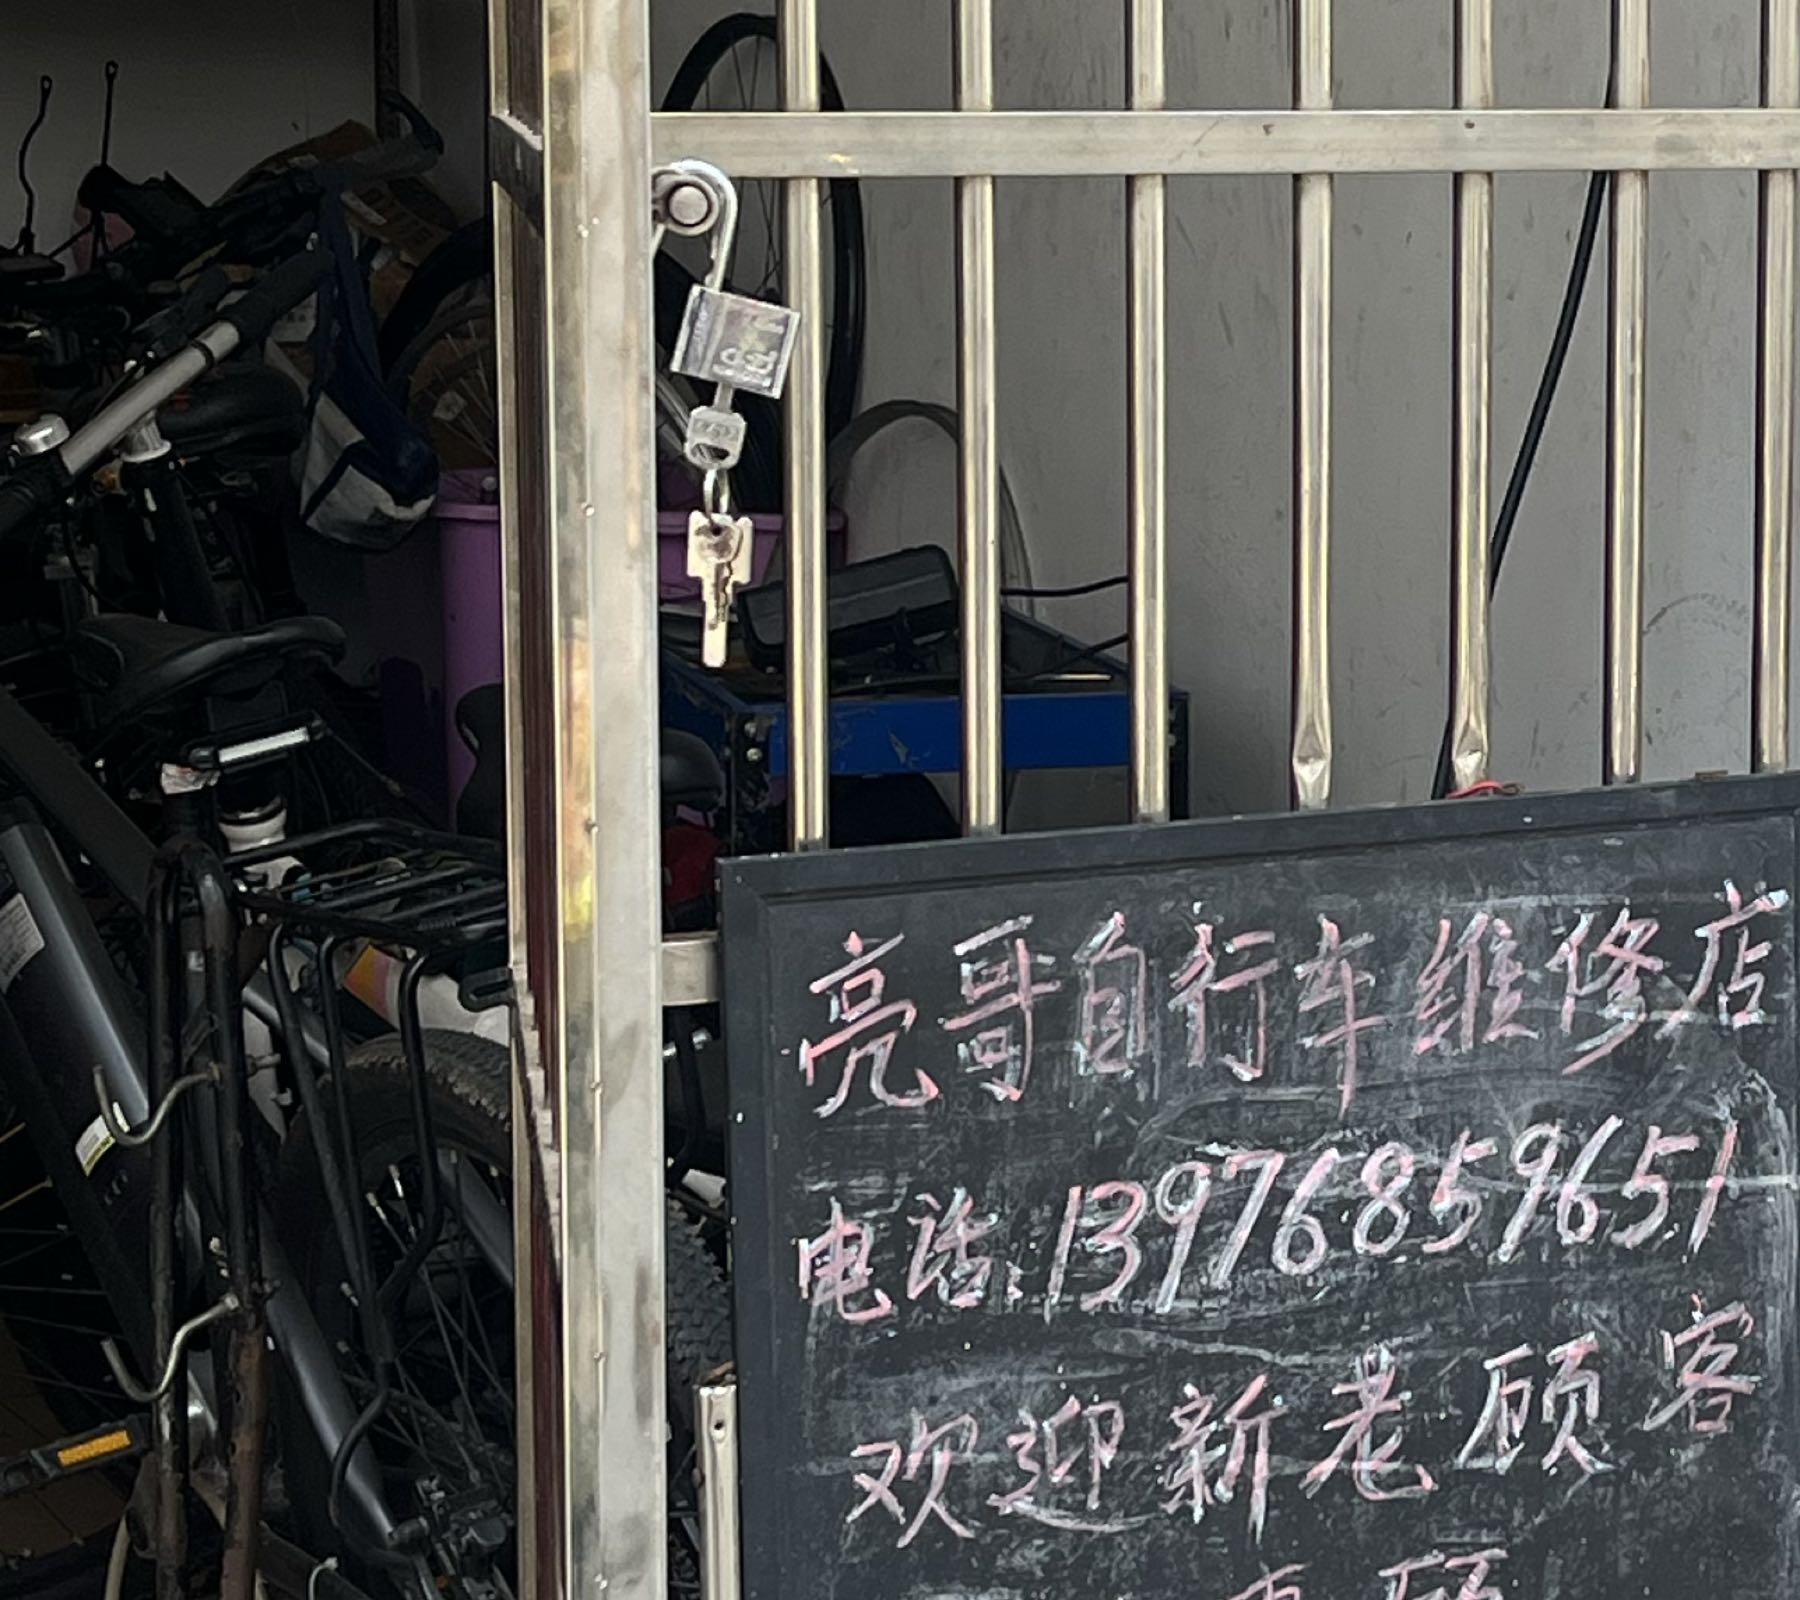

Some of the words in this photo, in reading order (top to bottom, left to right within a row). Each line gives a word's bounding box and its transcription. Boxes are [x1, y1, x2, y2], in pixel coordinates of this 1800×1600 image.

[800, 878, 1789, 1118] 亮哥自行车维修店
[844, 1295, 1761, 1547] 欢迎新老顾客
